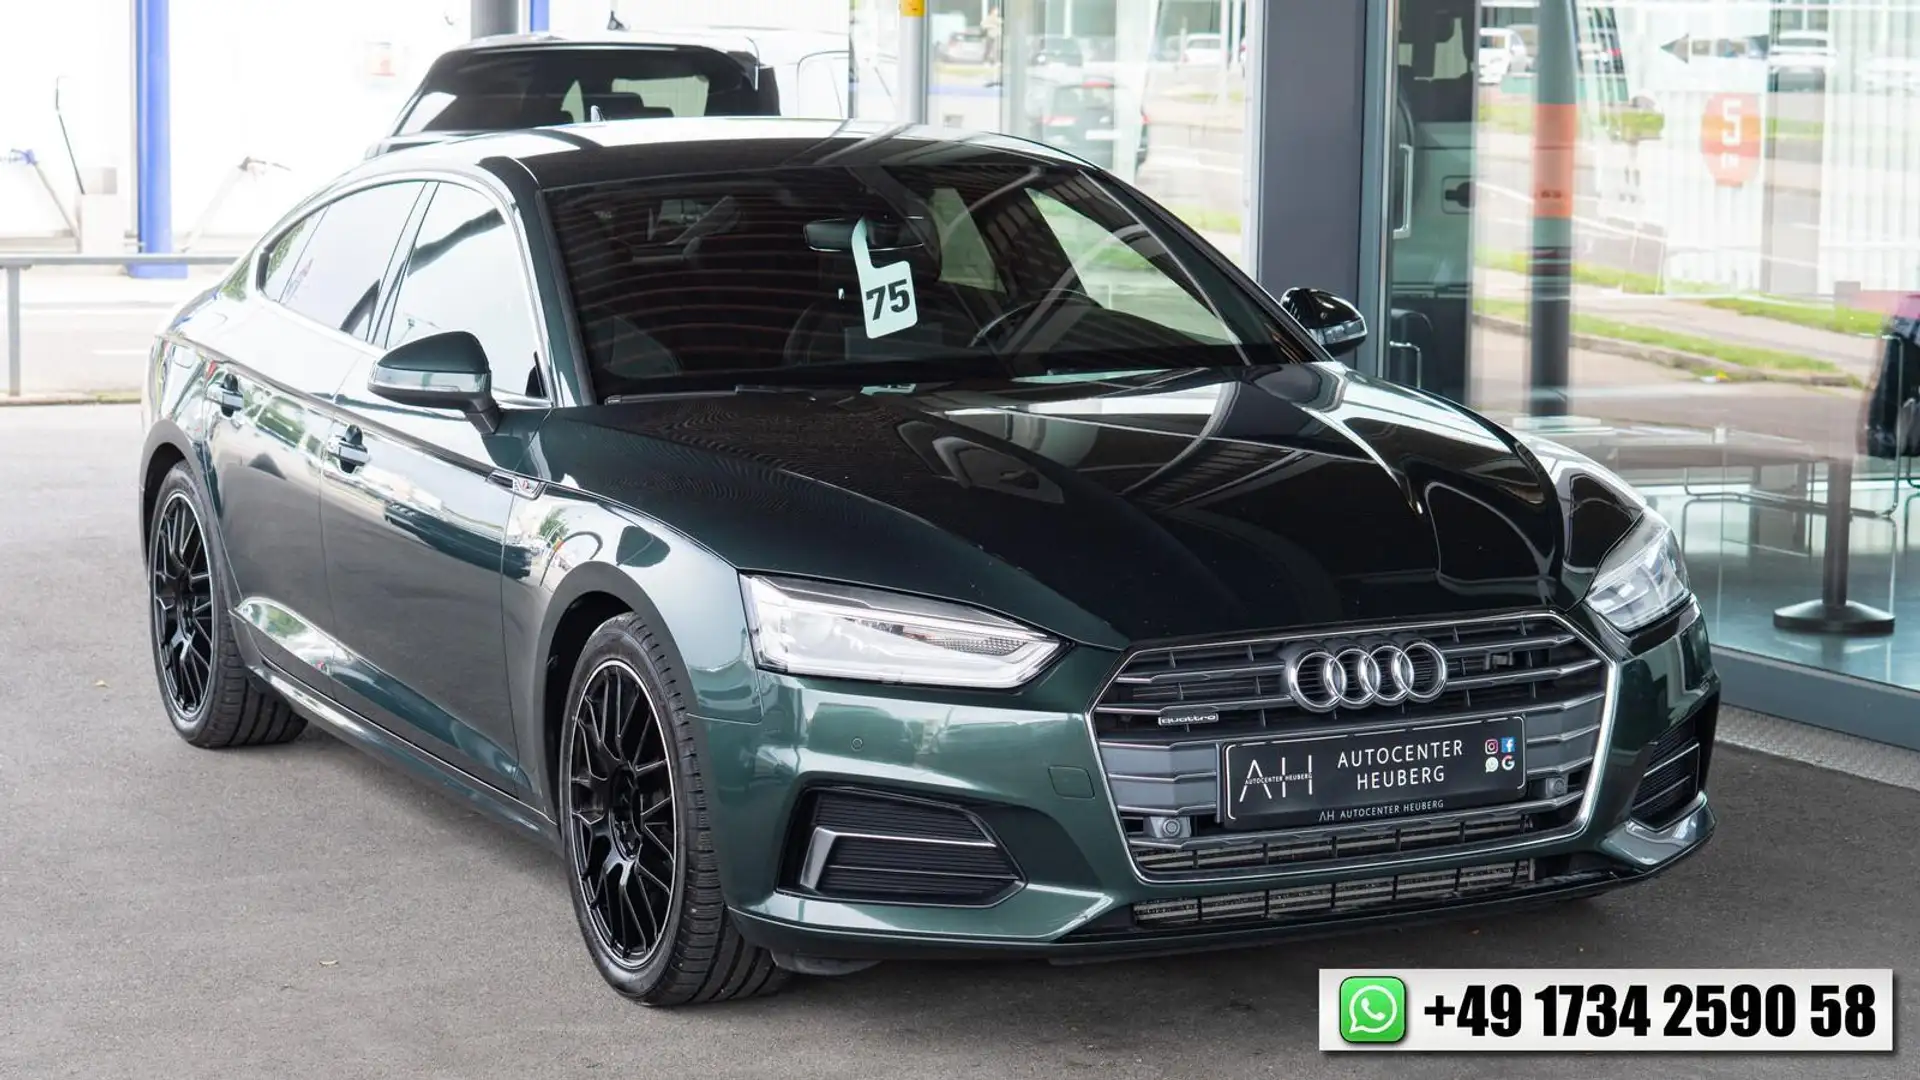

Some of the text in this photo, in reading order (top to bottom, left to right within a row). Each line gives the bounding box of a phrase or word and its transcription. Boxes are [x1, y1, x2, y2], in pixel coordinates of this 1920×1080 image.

[865, 278, 911, 321] 75
[1161, 714, 1216, 724] quattro
[1337, 739, 1463, 769] AUTOCENTER
[1239, 754, 1313, 802] AH
[1357, 765, 1445, 791] HEUBERG
[1318, 800, 1444, 822] AH AUTOCENTER HEUBERG
